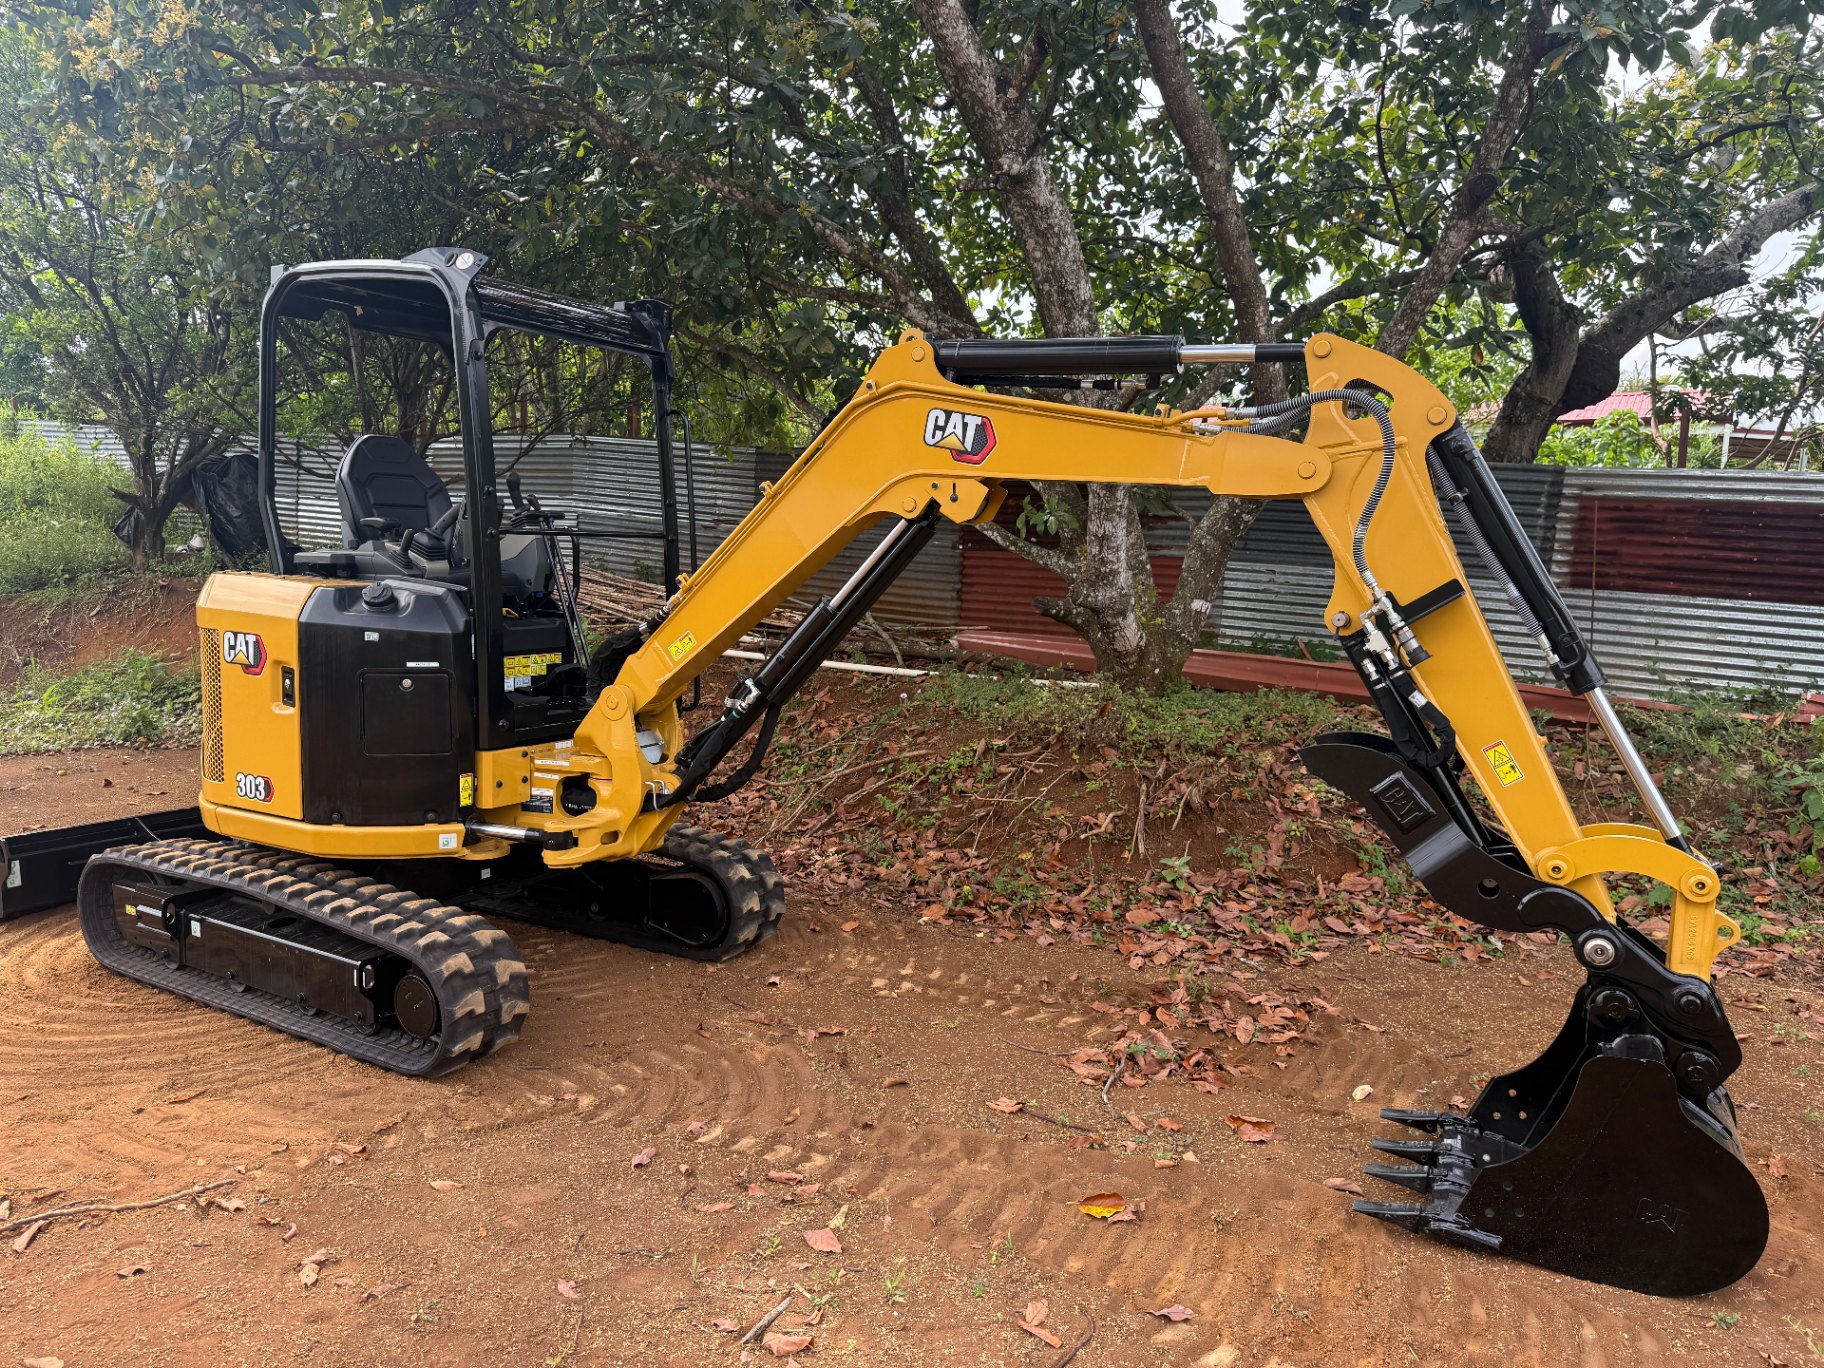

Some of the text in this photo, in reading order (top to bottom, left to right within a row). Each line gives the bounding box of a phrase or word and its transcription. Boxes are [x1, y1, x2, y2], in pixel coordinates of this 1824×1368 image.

[924, 408, 982, 452] CAT
[223, 631, 257, 666] CAT
[236, 772, 265, 800] 303
